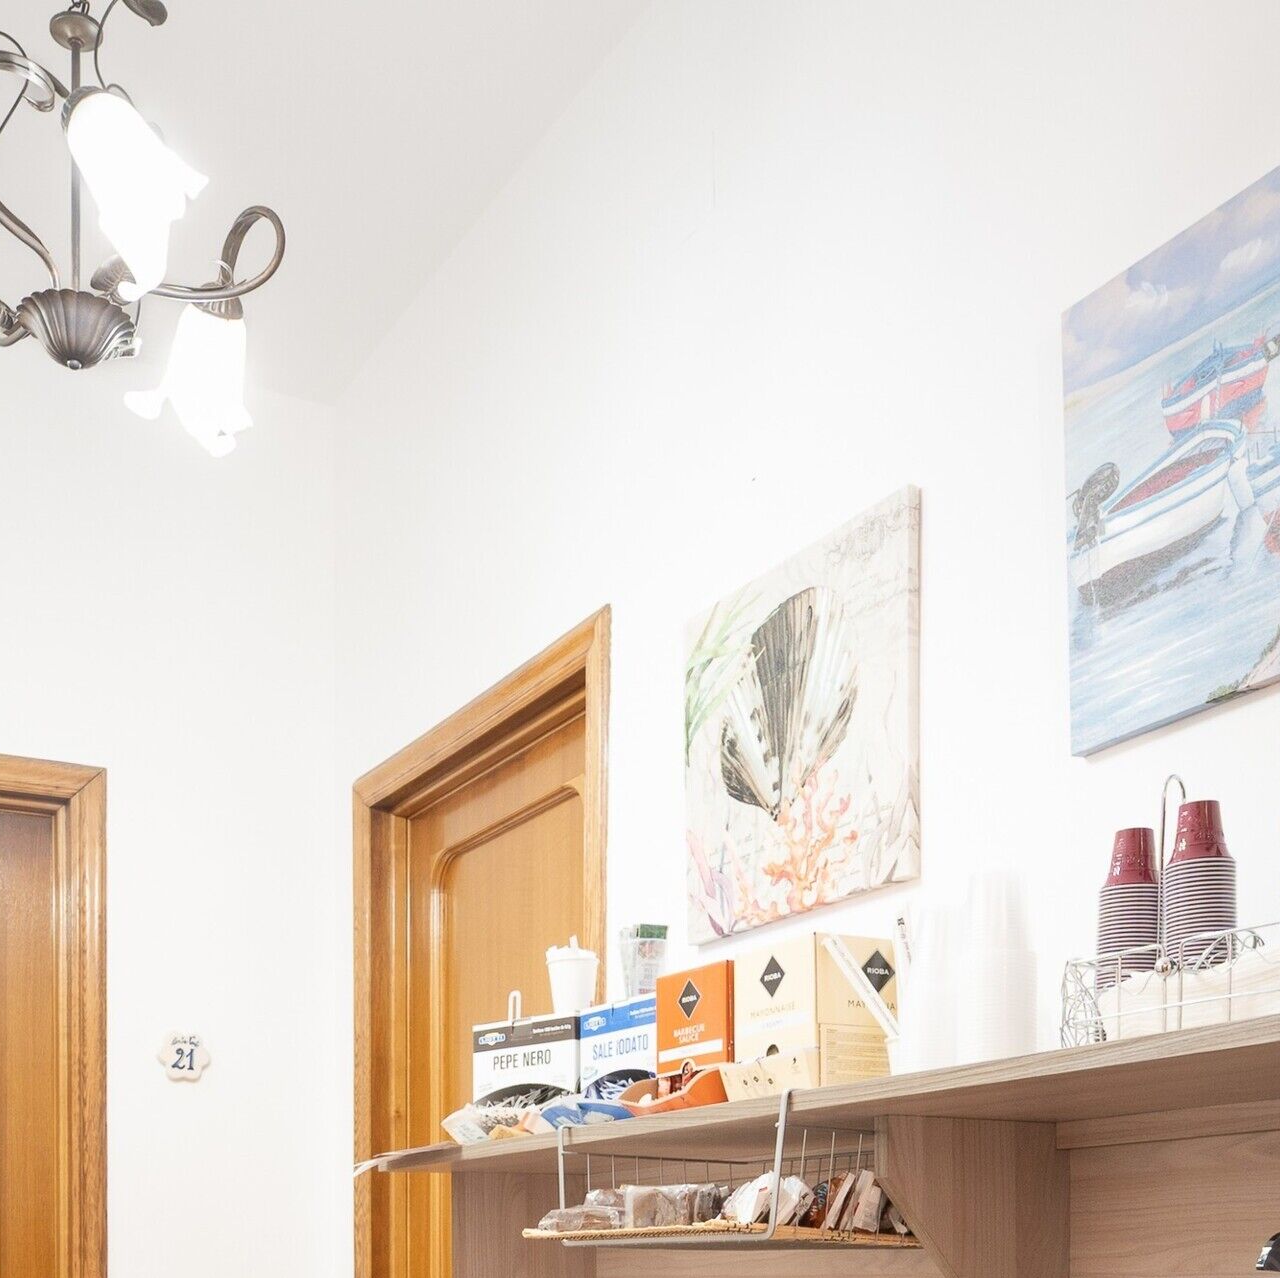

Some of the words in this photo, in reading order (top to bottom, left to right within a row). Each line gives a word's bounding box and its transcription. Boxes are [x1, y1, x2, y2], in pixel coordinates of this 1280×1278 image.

[764, 972, 782, 982] RIOBA
[866, 967, 890, 976] RIOBA
[171, 1047, 195, 1070] 21
[592, 1041, 613, 1061] SALE
[615, 1034, 649, 1056] IODATO
[493, 1053, 518, 1071] PEPE
[522, 1049, 551, 1067] NERO
